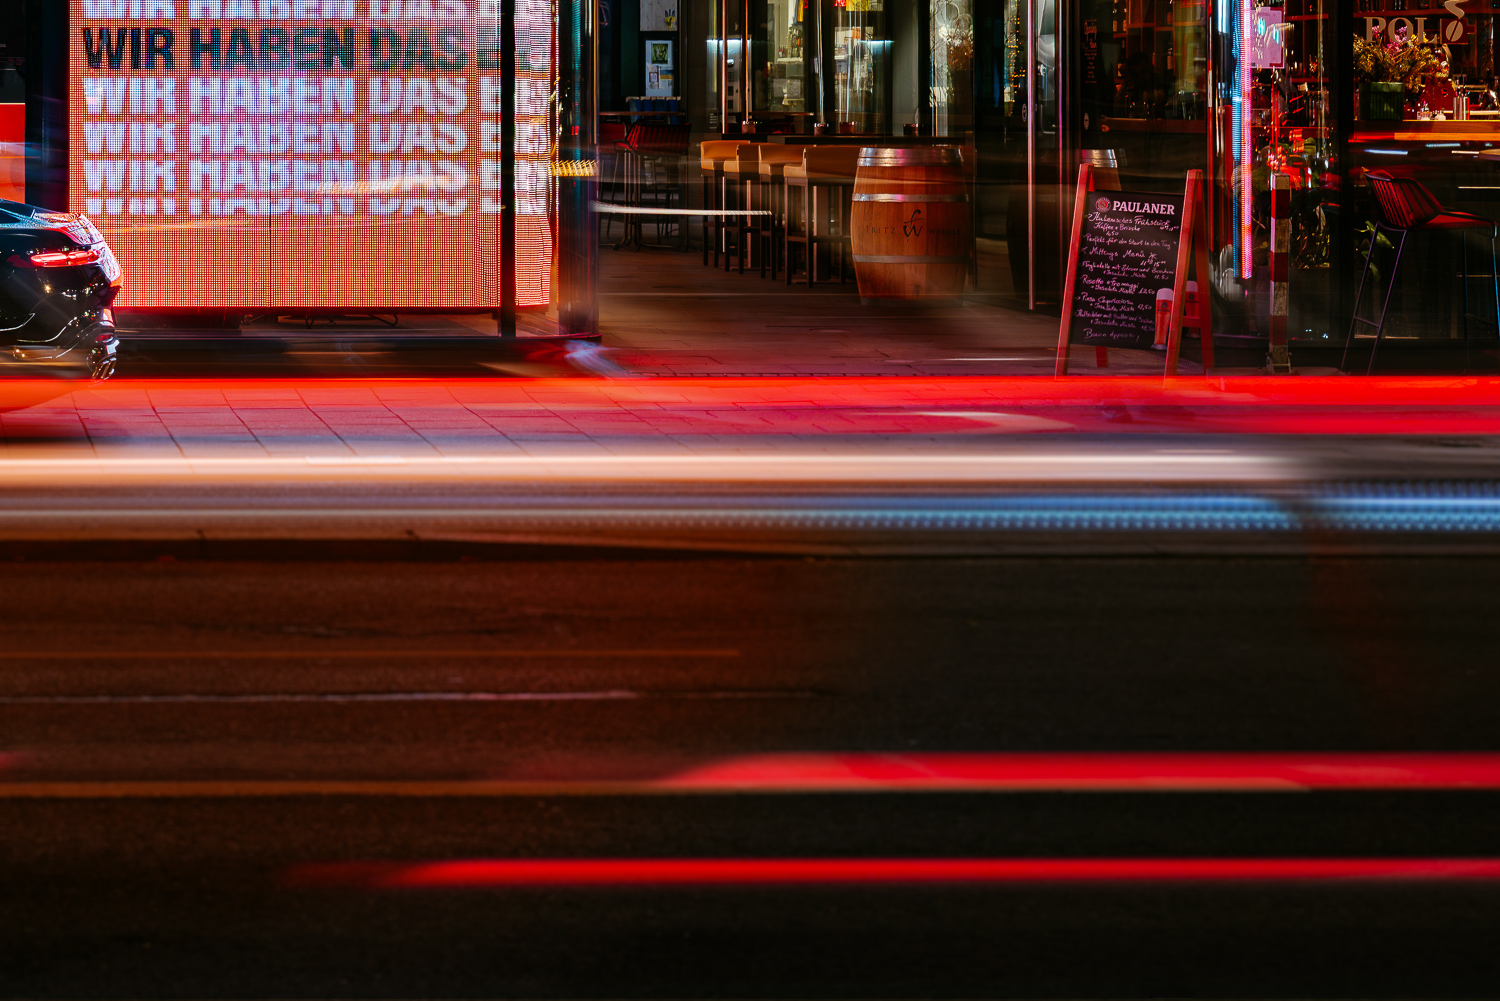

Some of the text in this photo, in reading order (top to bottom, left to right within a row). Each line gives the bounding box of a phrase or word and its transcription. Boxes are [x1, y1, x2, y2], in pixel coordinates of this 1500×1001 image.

[83, 27, 468, 70] WIR HABEN DAS
[1112, 201, 1175, 215] PAULANER
